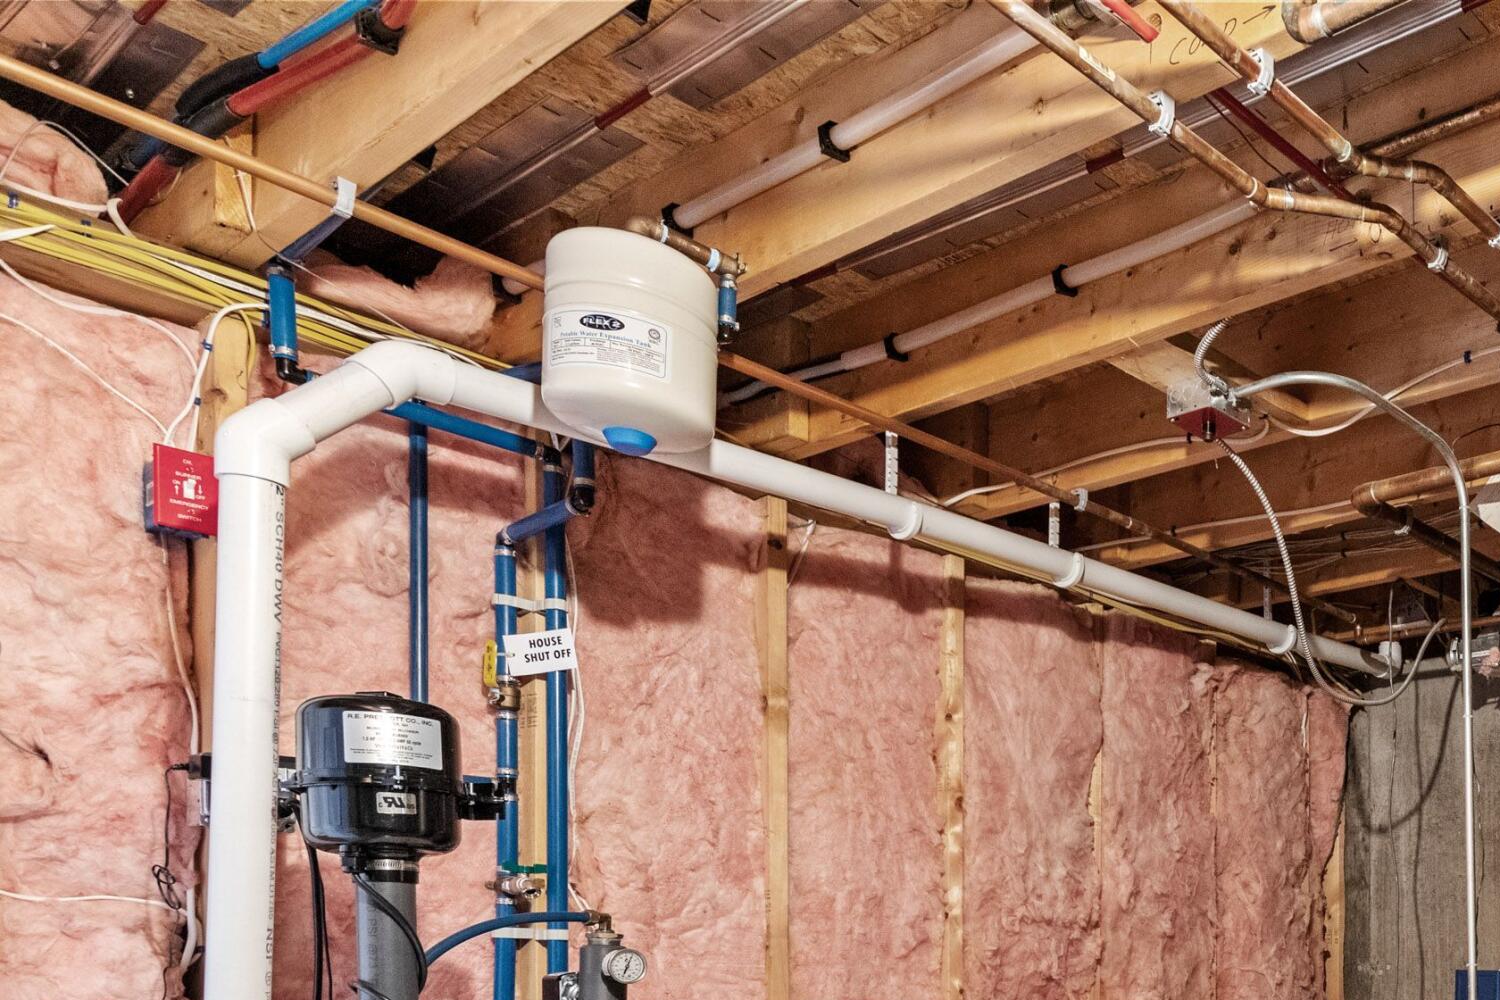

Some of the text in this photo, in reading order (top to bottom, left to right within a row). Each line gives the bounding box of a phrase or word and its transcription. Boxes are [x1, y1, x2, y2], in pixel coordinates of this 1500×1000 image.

[599, 332, 634, 344] Expansion
[635, 339, 652, 348] Tank
[175, 470, 202, 480] BURNER
[169, 498, 209, 510] EMERGENCY
[177, 513, 202, 522] SWITCH
[273, 579, 283, 624] DWV
[528, 636, 562, 649] HOUSE
[524, 648, 571, 663] SHUT OFF
